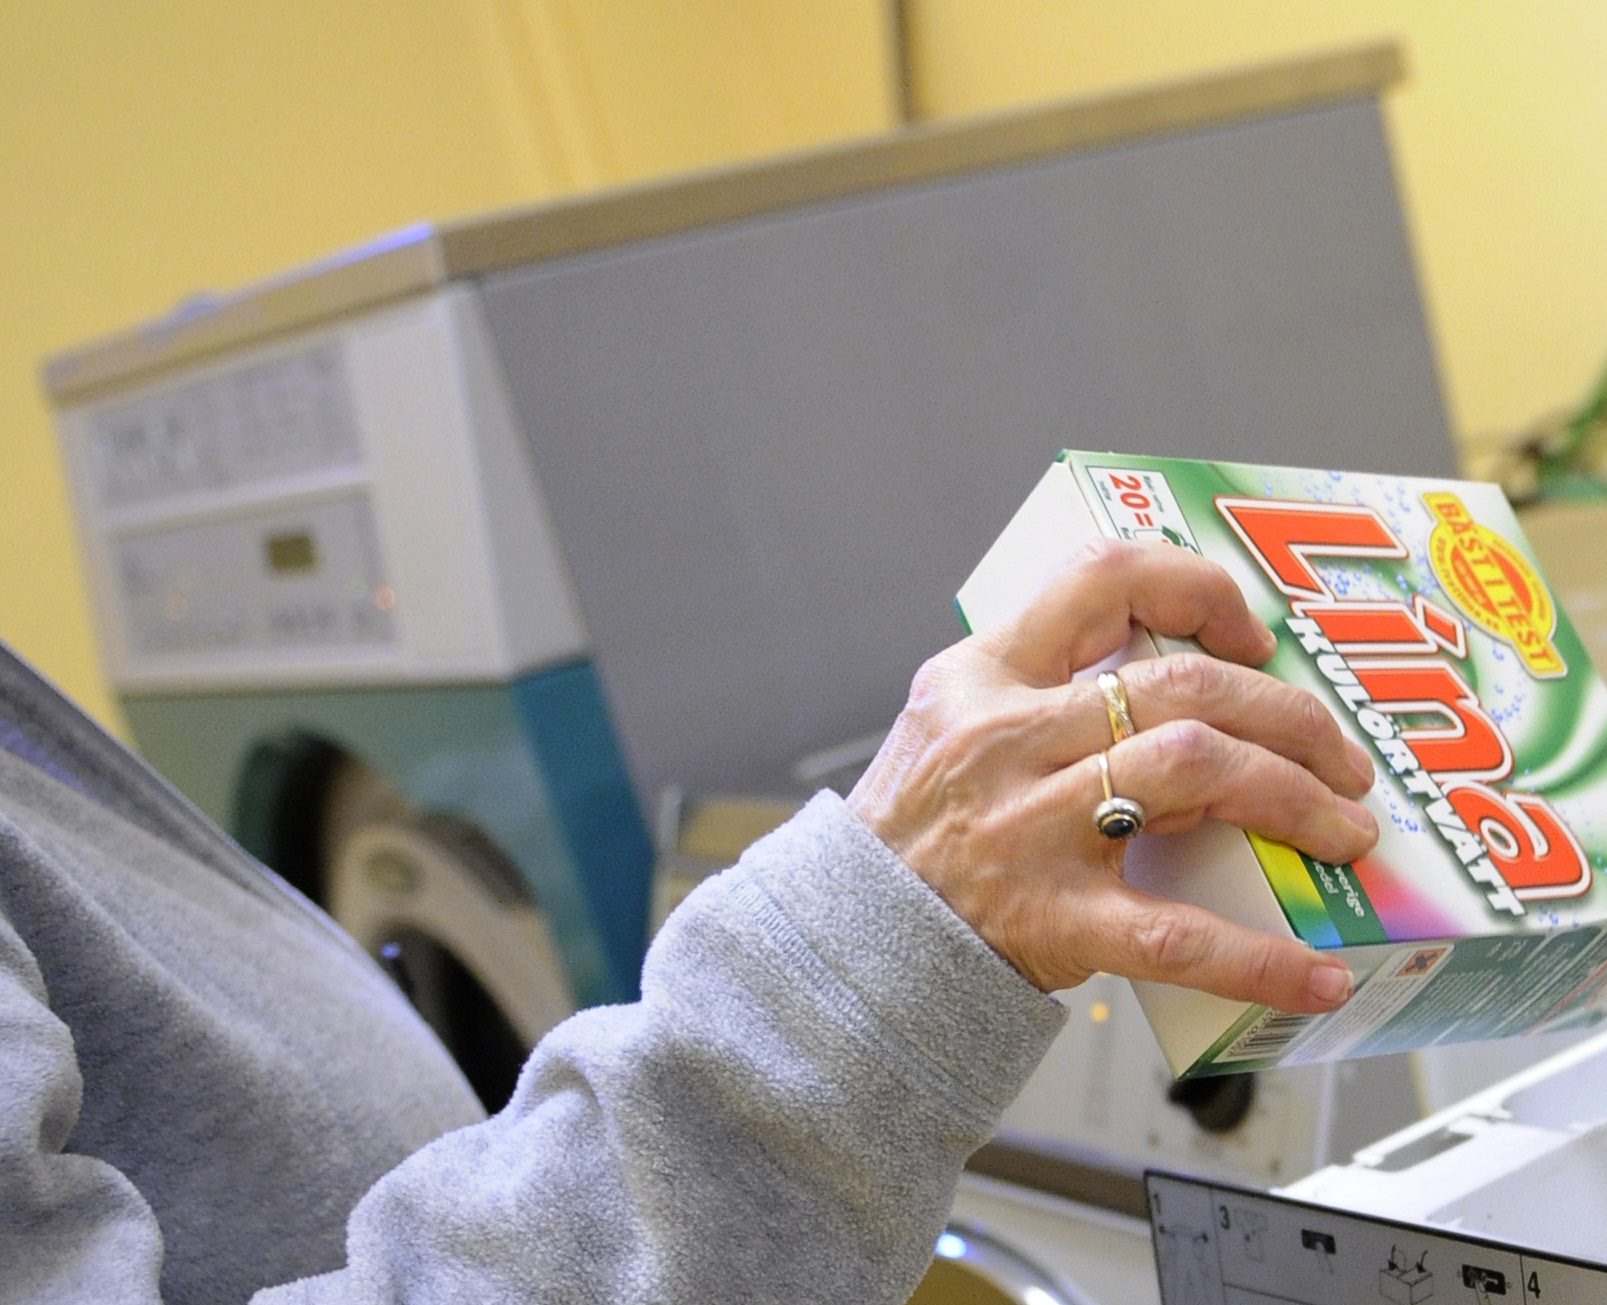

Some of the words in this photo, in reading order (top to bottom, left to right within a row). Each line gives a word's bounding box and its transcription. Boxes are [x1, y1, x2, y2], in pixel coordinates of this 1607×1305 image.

[1435, 502, 1495, 566] BÄST
[1498, 595, 1554, 664] TEST
[1284, 616, 1528, 918] KULÖRTVÄTT
[1312, 861, 1340, 895] edel
[1334, 866, 1365, 918] verige
[1218, 1205, 1231, 1231] 3
[1527, 1271, 1541, 1299] 4
